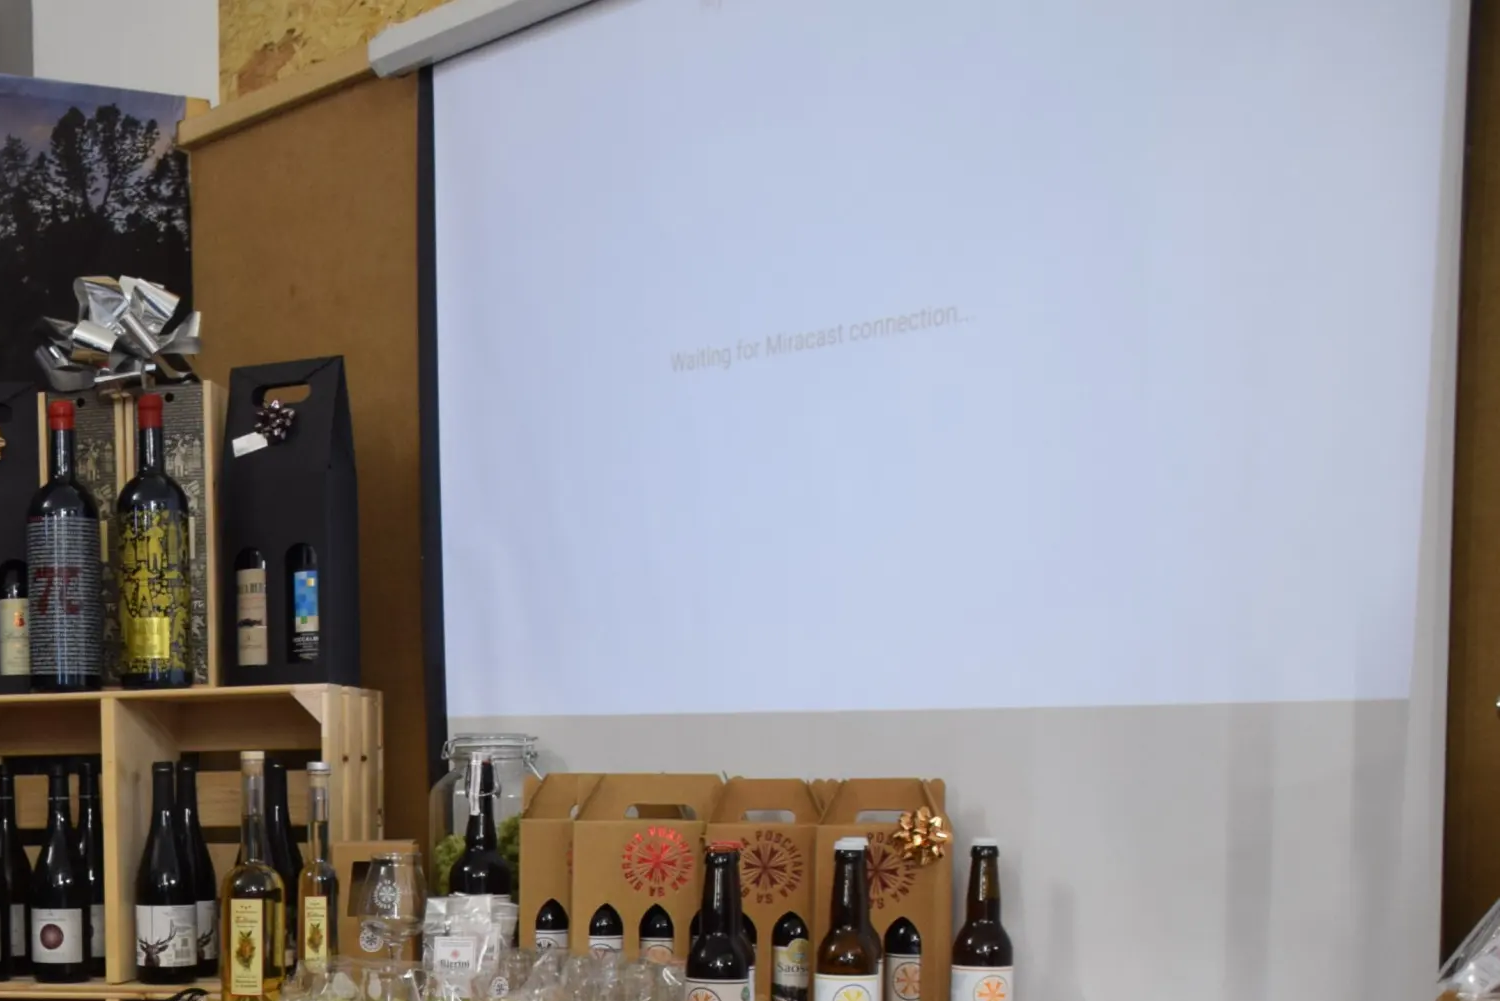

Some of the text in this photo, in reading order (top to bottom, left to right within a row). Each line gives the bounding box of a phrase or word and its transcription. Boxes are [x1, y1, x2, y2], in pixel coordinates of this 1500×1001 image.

[670, 347, 731, 373] Waiting
[736, 338, 760, 362] for
[766, 323, 843, 357] Miracast
